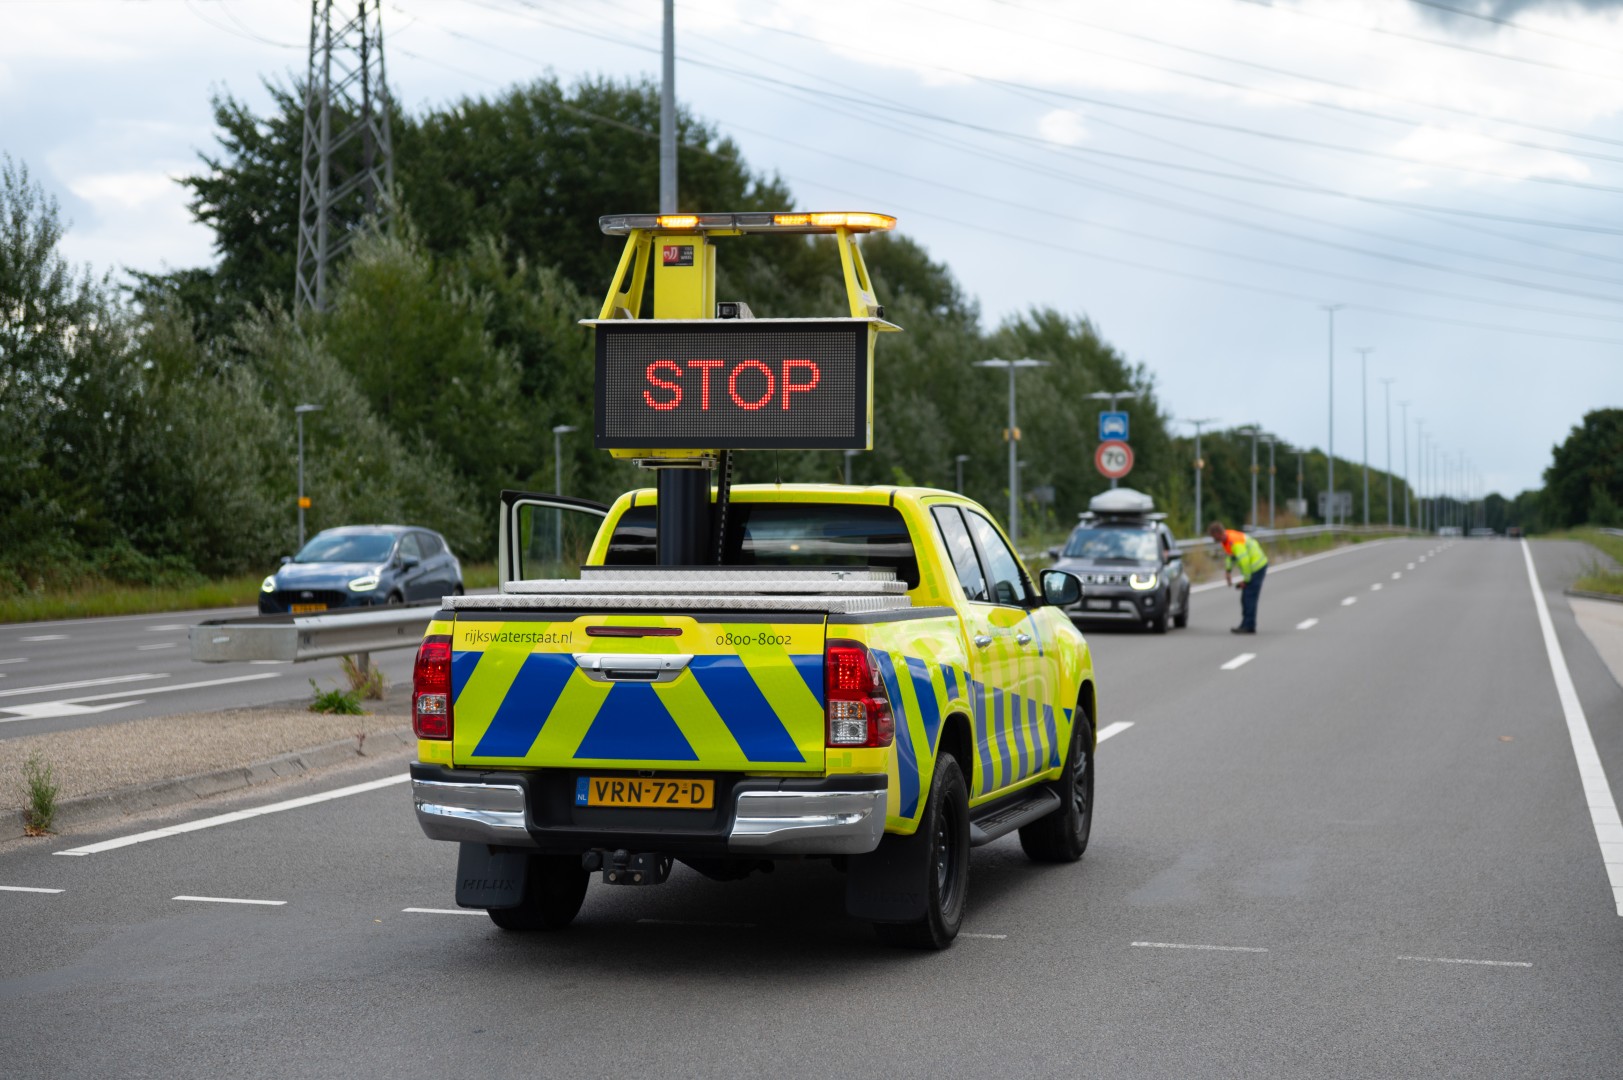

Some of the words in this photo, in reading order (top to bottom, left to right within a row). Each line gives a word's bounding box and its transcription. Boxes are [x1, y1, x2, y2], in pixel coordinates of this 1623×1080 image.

[642, 359, 821, 411] STOP
[1104, 450, 1127, 467] 70
[464, 630, 573, 645] rijkswaterstaat.nl
[715, 632, 792, 646] 0800-8002
[577, 793, 587, 801] NL
[595, 780, 705, 805] VRN-72-D
